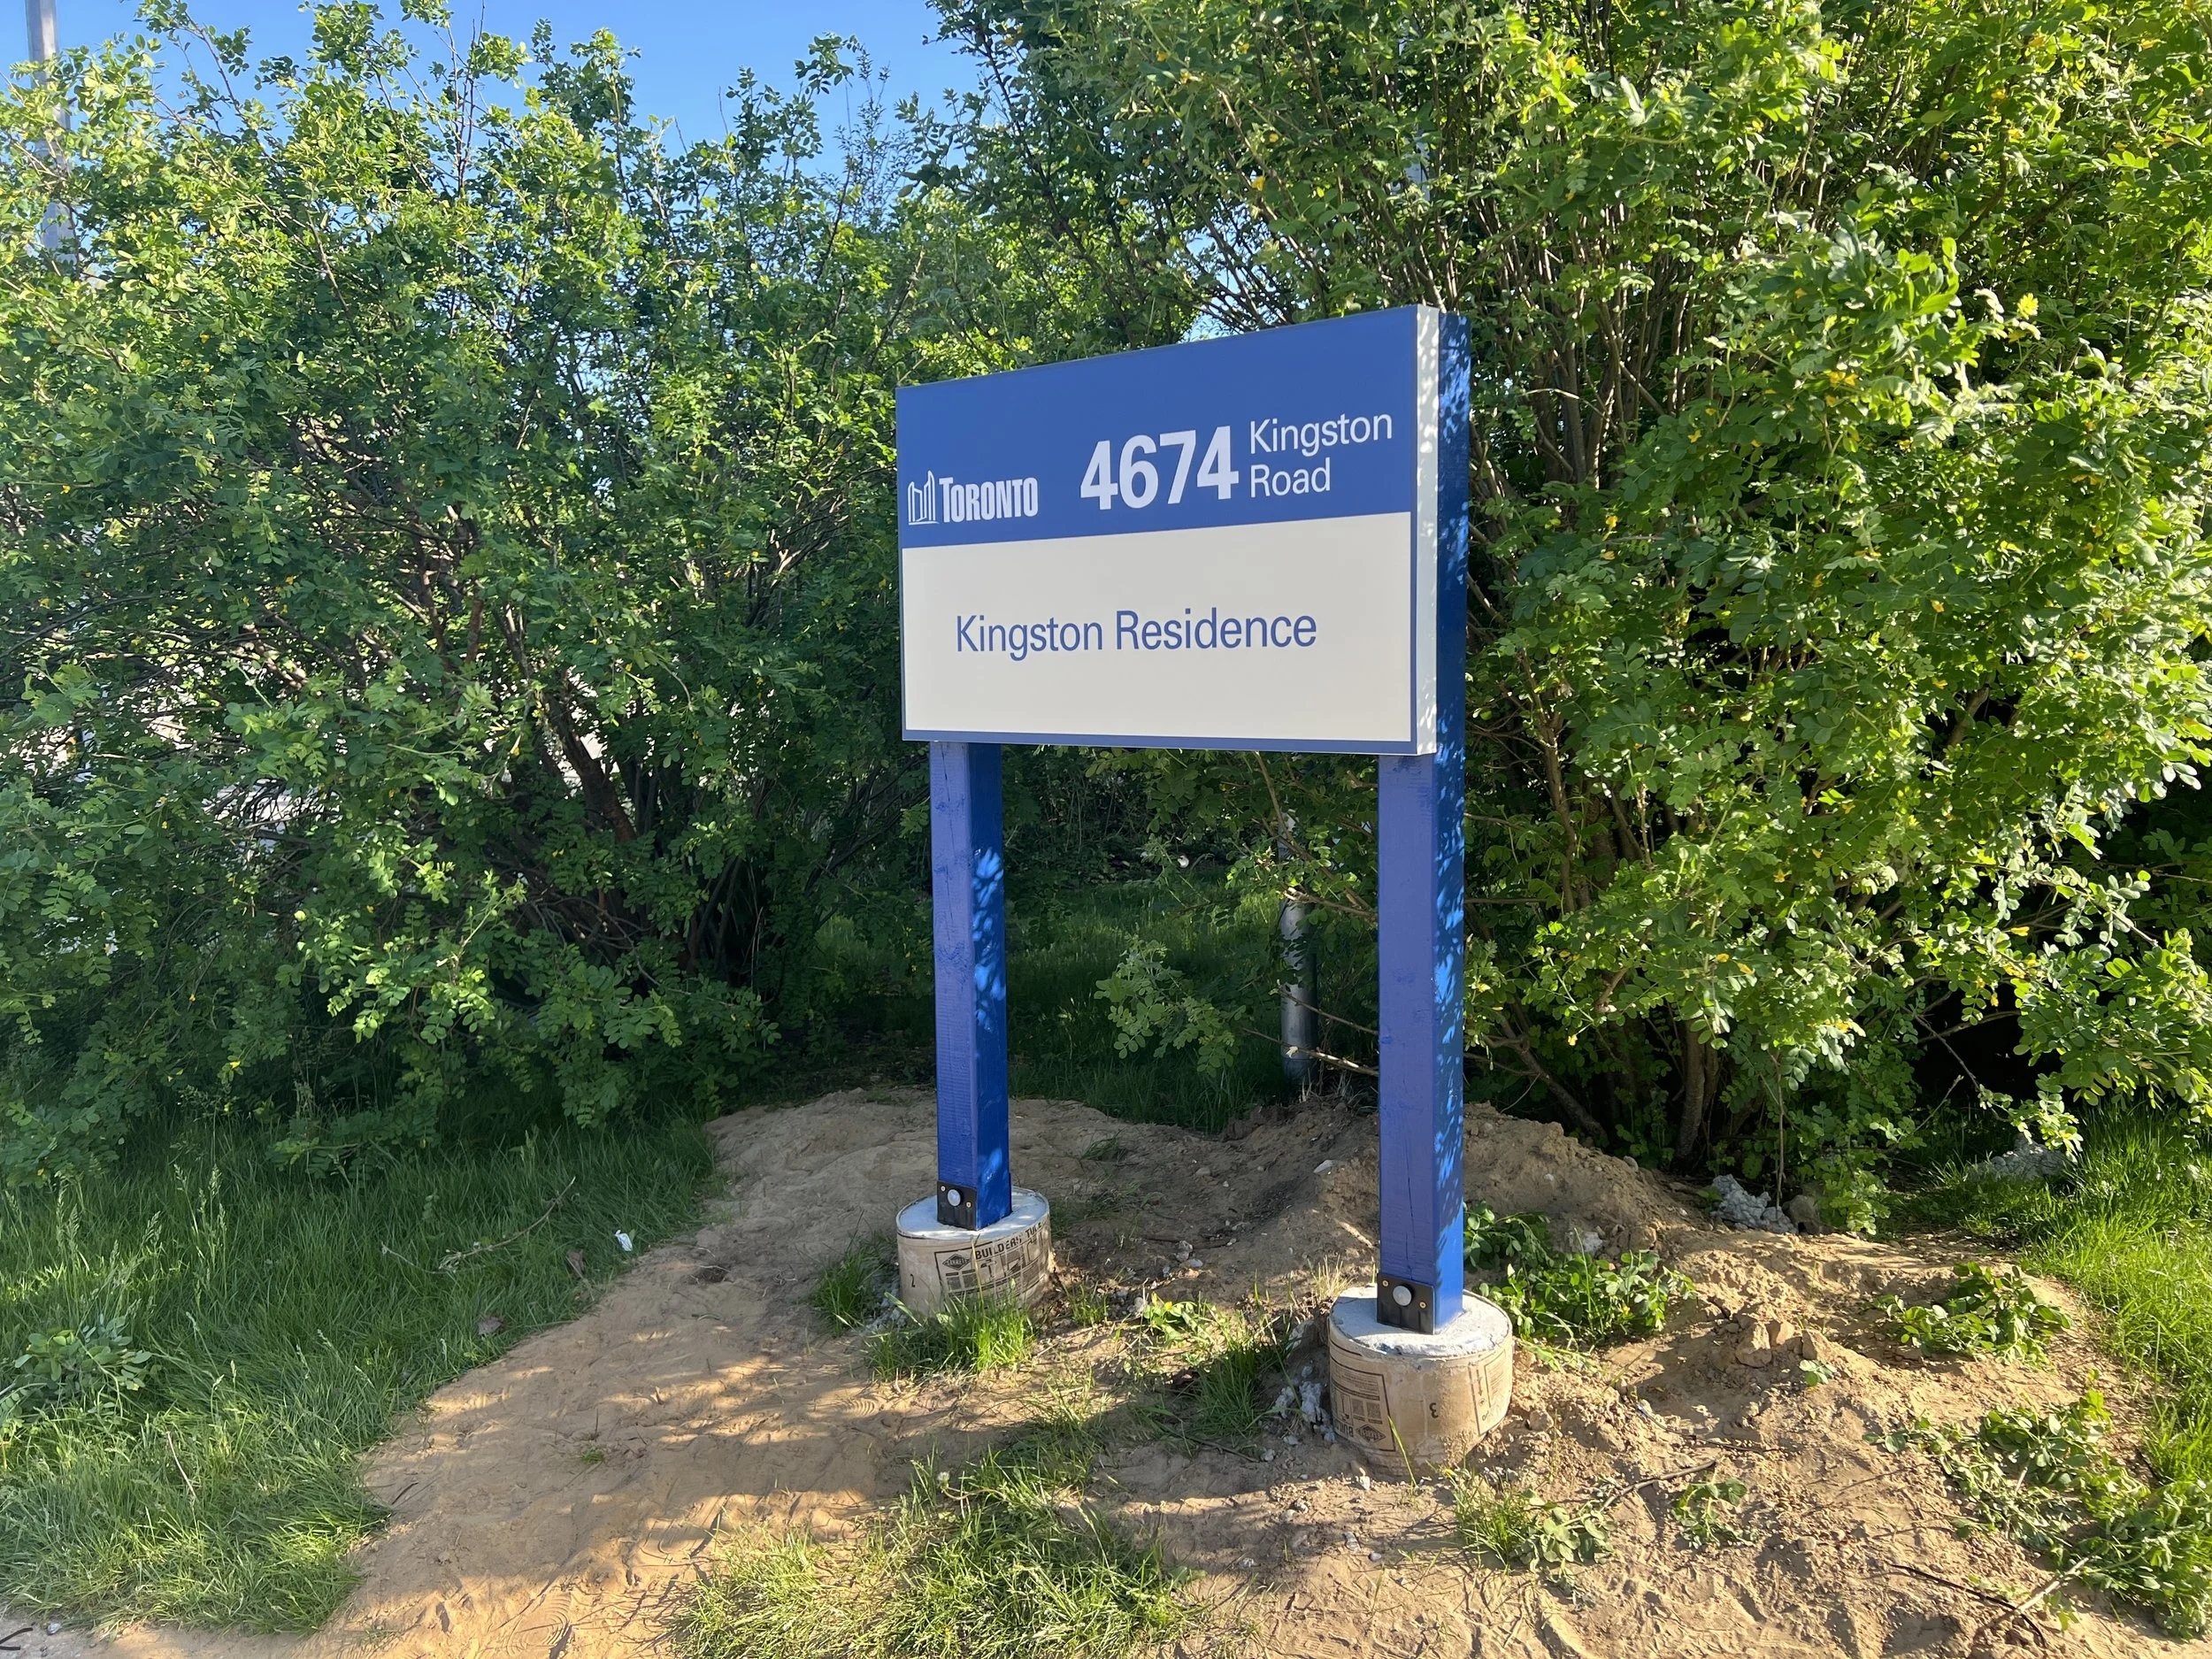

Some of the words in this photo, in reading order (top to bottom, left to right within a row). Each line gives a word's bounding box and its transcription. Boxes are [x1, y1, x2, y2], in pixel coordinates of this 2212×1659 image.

[1249, 413, 1394, 457] Kingston
[1079, 425, 1240, 511] 4674
[1249, 458, 1332, 498] Road
[939, 476, 1040, 523] TORONTO
[956, 614, 1103, 662] Kingston
[1116, 606, 1317, 650] Residence
